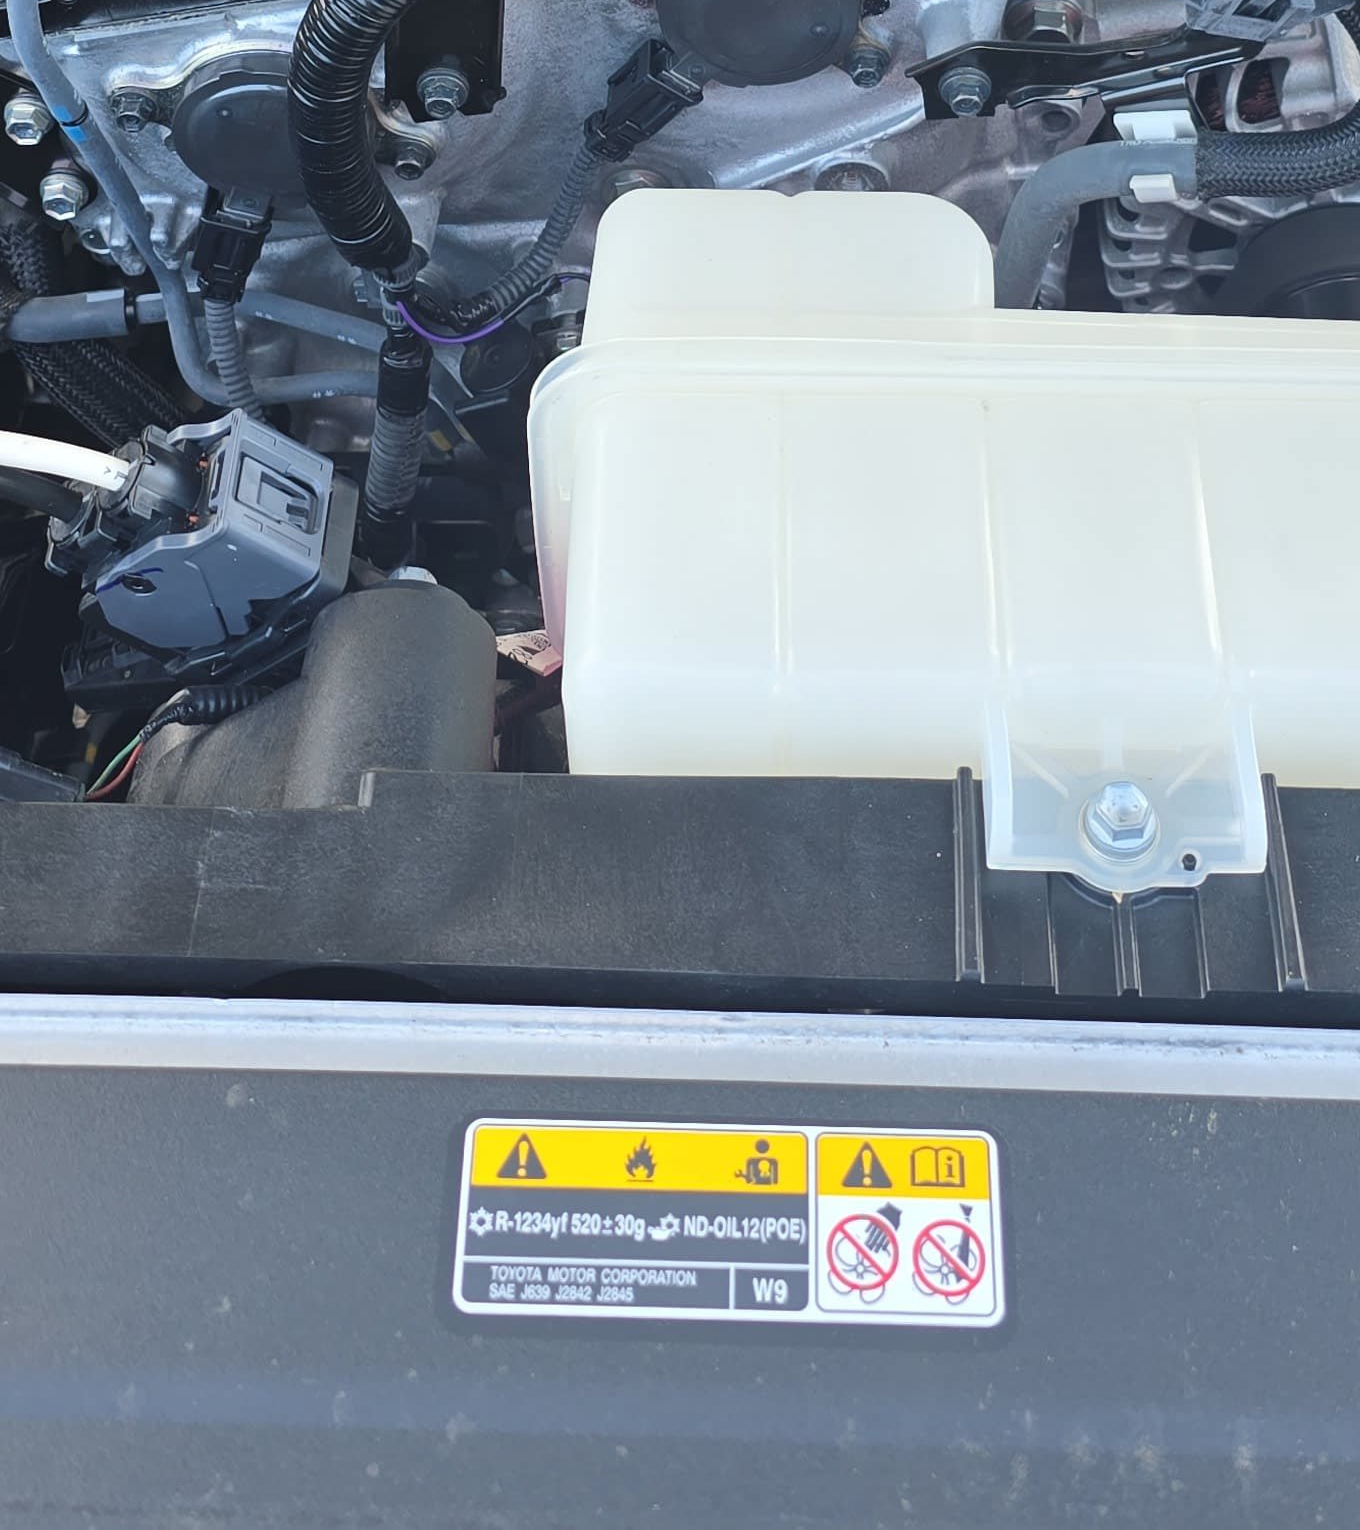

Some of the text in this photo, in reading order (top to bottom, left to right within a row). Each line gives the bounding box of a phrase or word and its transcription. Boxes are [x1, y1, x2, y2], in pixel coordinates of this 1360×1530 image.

[494, 1210, 806, 1244] R-1234yf 520±30g ND-OIL12(POE)
[490, 1265, 697, 1287] TOYOTA MOTOR CORPORATION
[489, 1283, 517, 1300] SAE
[752, 1279, 789, 1305] W9
